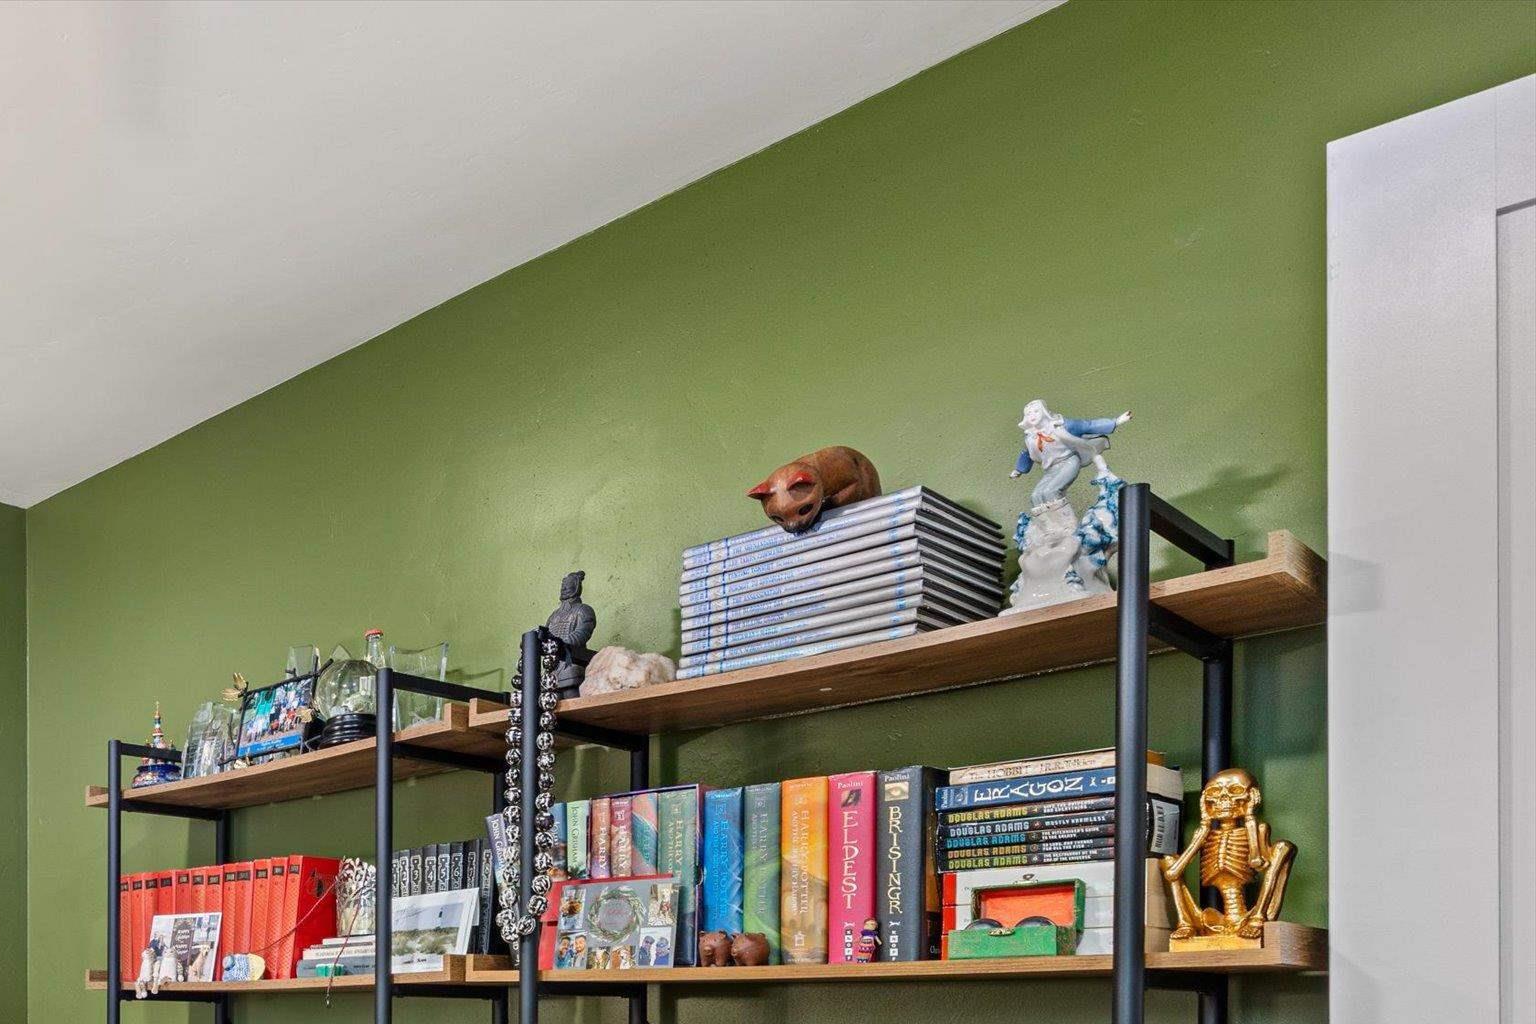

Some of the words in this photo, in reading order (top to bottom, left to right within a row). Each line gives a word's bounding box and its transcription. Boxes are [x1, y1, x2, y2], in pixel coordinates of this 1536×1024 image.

[837, 780, 864, 790] Paolini
[884, 772, 910, 782] Paolini
[974, 776, 1084, 802] ERAGON
[948, 810, 991, 824] DOUGLAS
[993, 806, 1028, 818] ADAMS
[800, 810, 810, 860] HARRY
[950, 824, 991, 837] DOUGLAS
[994, 821, 1030, 832] ADAMS
[598, 826, 606, 870] HARRY
[674, 820, 684, 866] HARRY
[946, 836, 988, 848] DOUGLAS
[992, 833, 1026, 845] ADAMS
[840, 810, 860, 910] ELDEST
[888, 806, 904, 914] BRISINGR
[948, 848, 989, 860] DOUGLAS
[992, 844, 1026, 856] ADAMS
[948, 858, 990, 870] DOUGLAS
[993, 855, 1028, 866] ADAMS
[800, 861, 810, 914] POTTER
